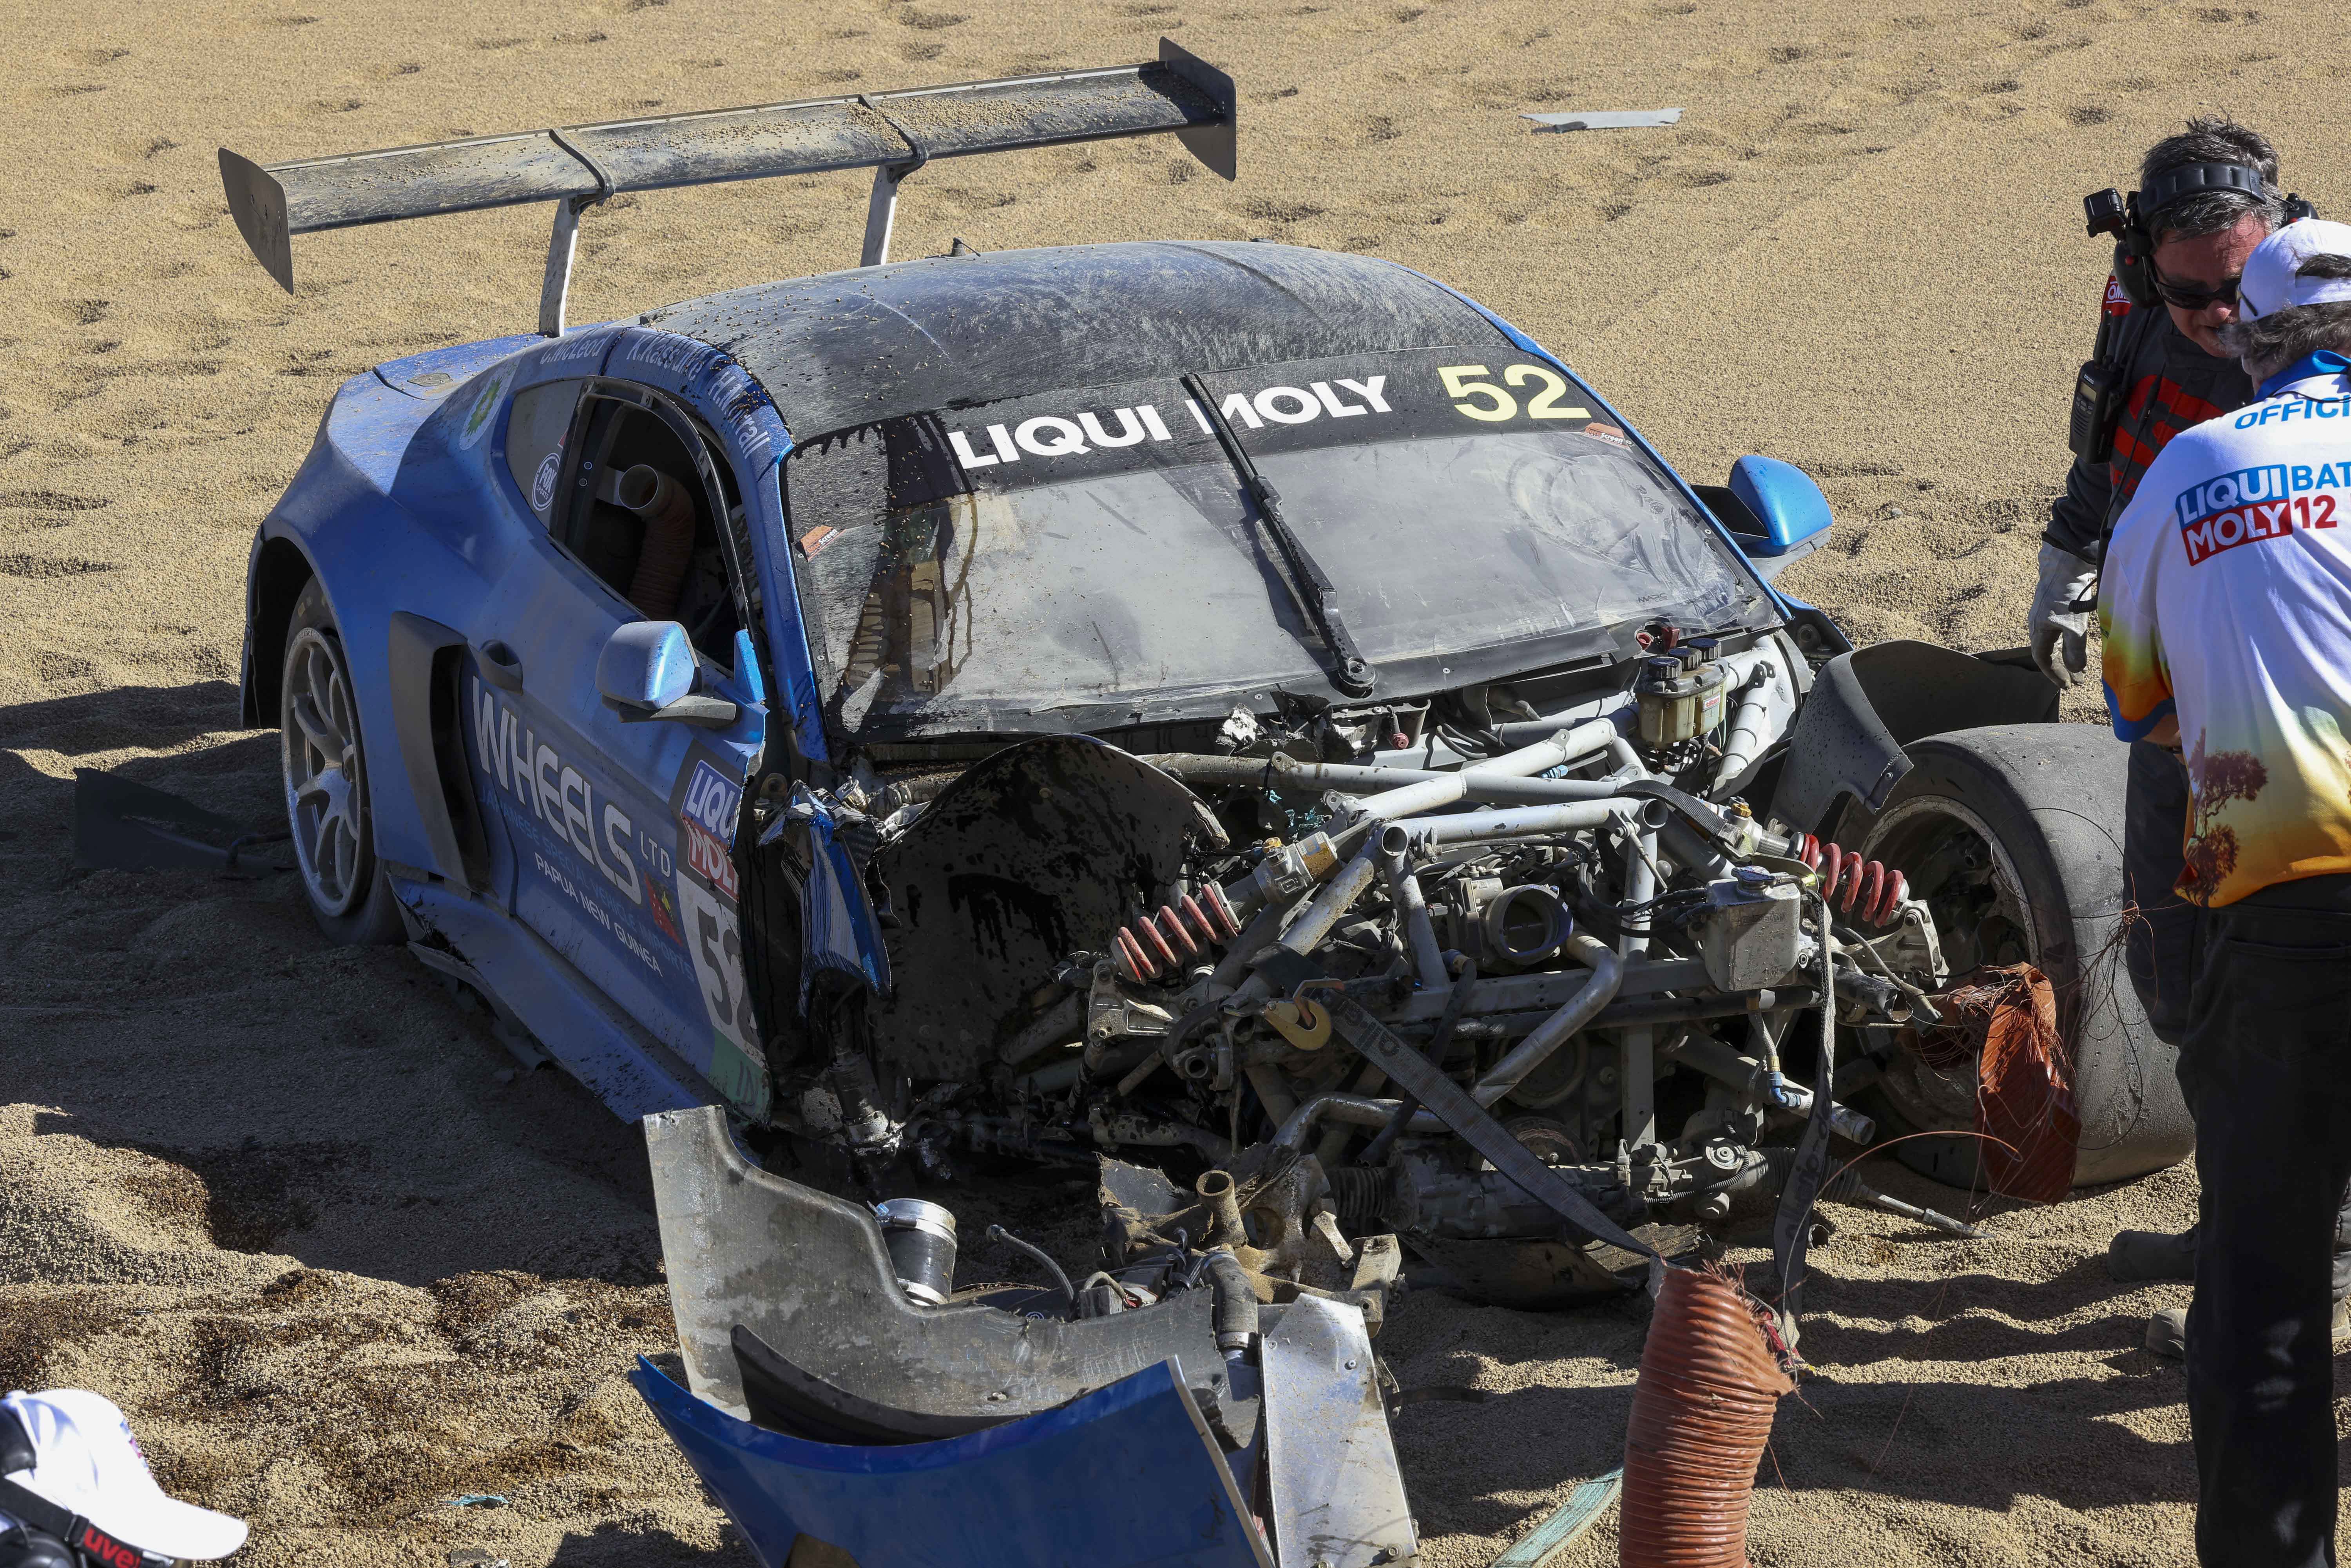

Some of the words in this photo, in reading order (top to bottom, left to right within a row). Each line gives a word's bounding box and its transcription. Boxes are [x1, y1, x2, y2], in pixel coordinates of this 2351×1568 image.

[2108, 285, 2126, 300] OM
[947, 405, 1172, 469] LIQUI
[1185, 375, 1393, 434] MOLY
[1437, 364, 1591, 422] 52
[536, 484, 549, 500] SPORTS
[539, 463, 557, 493] FOX
[2180, 467, 2283, 525] LIQUI
[2291, 461, 2351, 491] BAT
[2186, 502, 2288, 562] MOLY
[2294, 495, 2337, 529] 12
[473, 675, 642, 905] WHEELS
[640, 830, 671, 878] LTD
[534, 852, 579, 903] PAPUA
[580, 890, 611, 931] NEW
[614, 922, 663, 978] GUINEA
